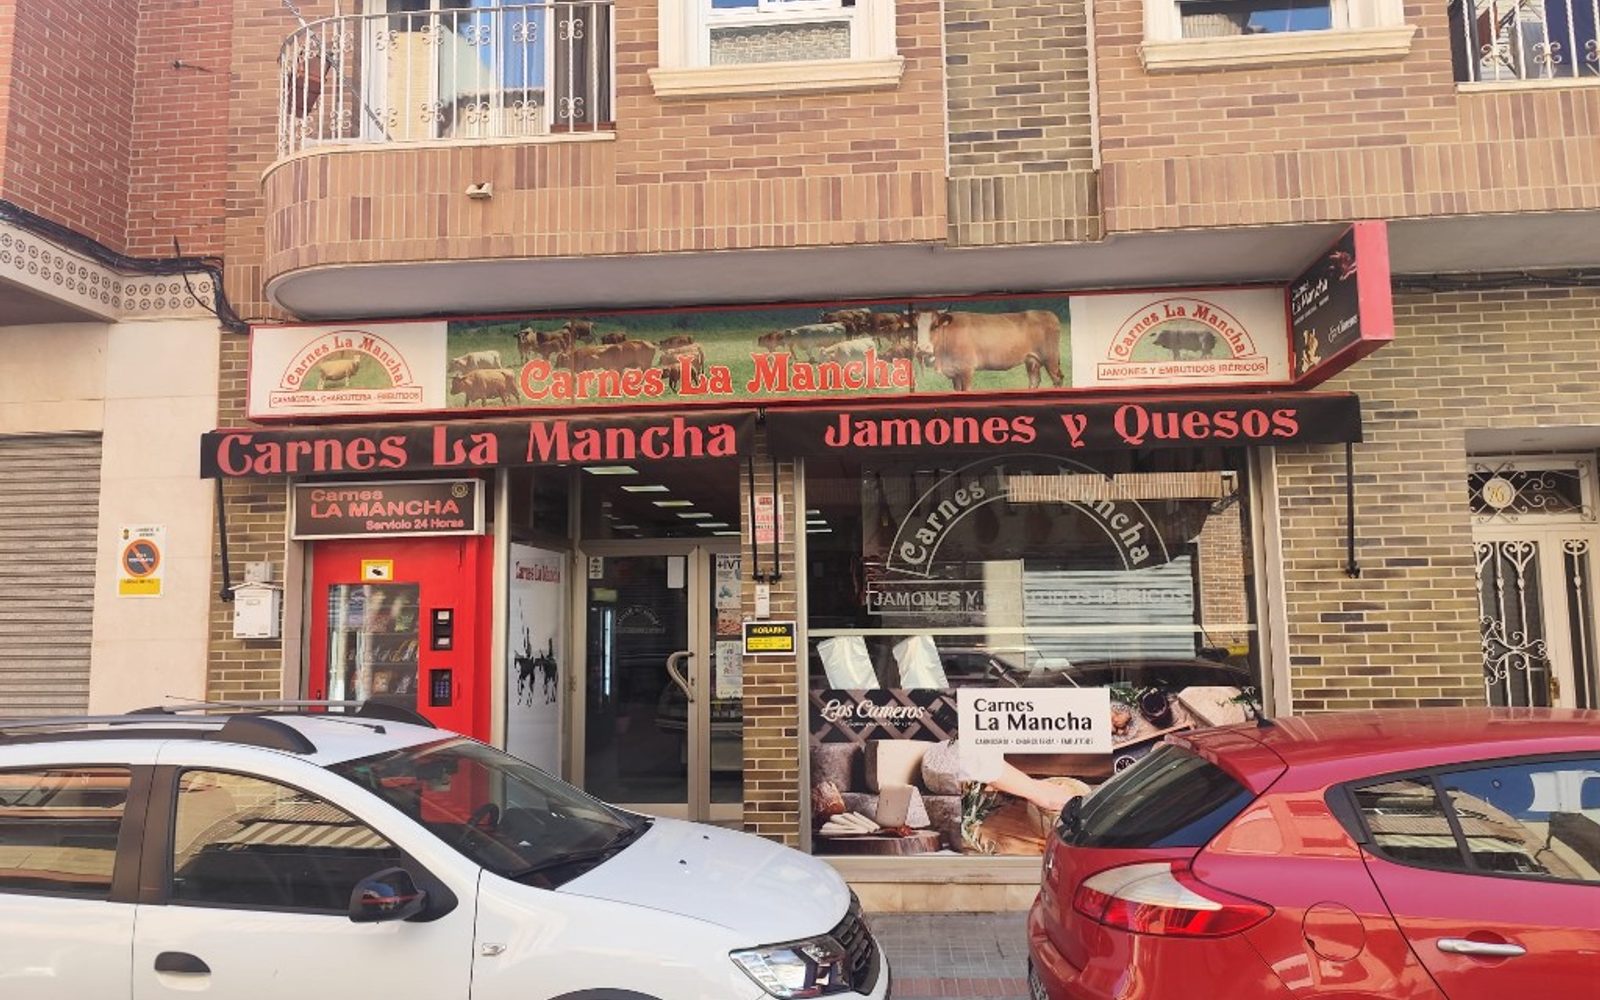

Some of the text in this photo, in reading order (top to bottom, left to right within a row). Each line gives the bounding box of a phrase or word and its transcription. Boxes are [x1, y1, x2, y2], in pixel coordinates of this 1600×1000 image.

[1114, 312, 1160, 357] Carnes
[1163, 304, 1186, 318] La
[1192, 304, 1246, 354] Mancha
[287, 336, 404, 386] Carnes La Mancha
[520, 348, 917, 400] Carnes La Mancha
[1101, 367, 1148, 377] JAMONES
[1150, 367, 1156, 375] Y
[825, 403, 1299, 448] Jamones y Quesos
[217, 415, 737, 476] Carnes La Mancha
[311, 489, 383, 502] Carnes
[311, 500, 459, 518] LA MANCHA
[366, 518, 465, 531] Servicio 24 Horas
[900, 481, 986, 565] Carnes
[873, 591, 961, 606] JAMONES
[966, 590, 978, 605] Y
[820, 699, 925, 722] Los Cameros
[974, 698, 1034, 712] Carnes
[975, 711, 1092, 731] La Mancha
